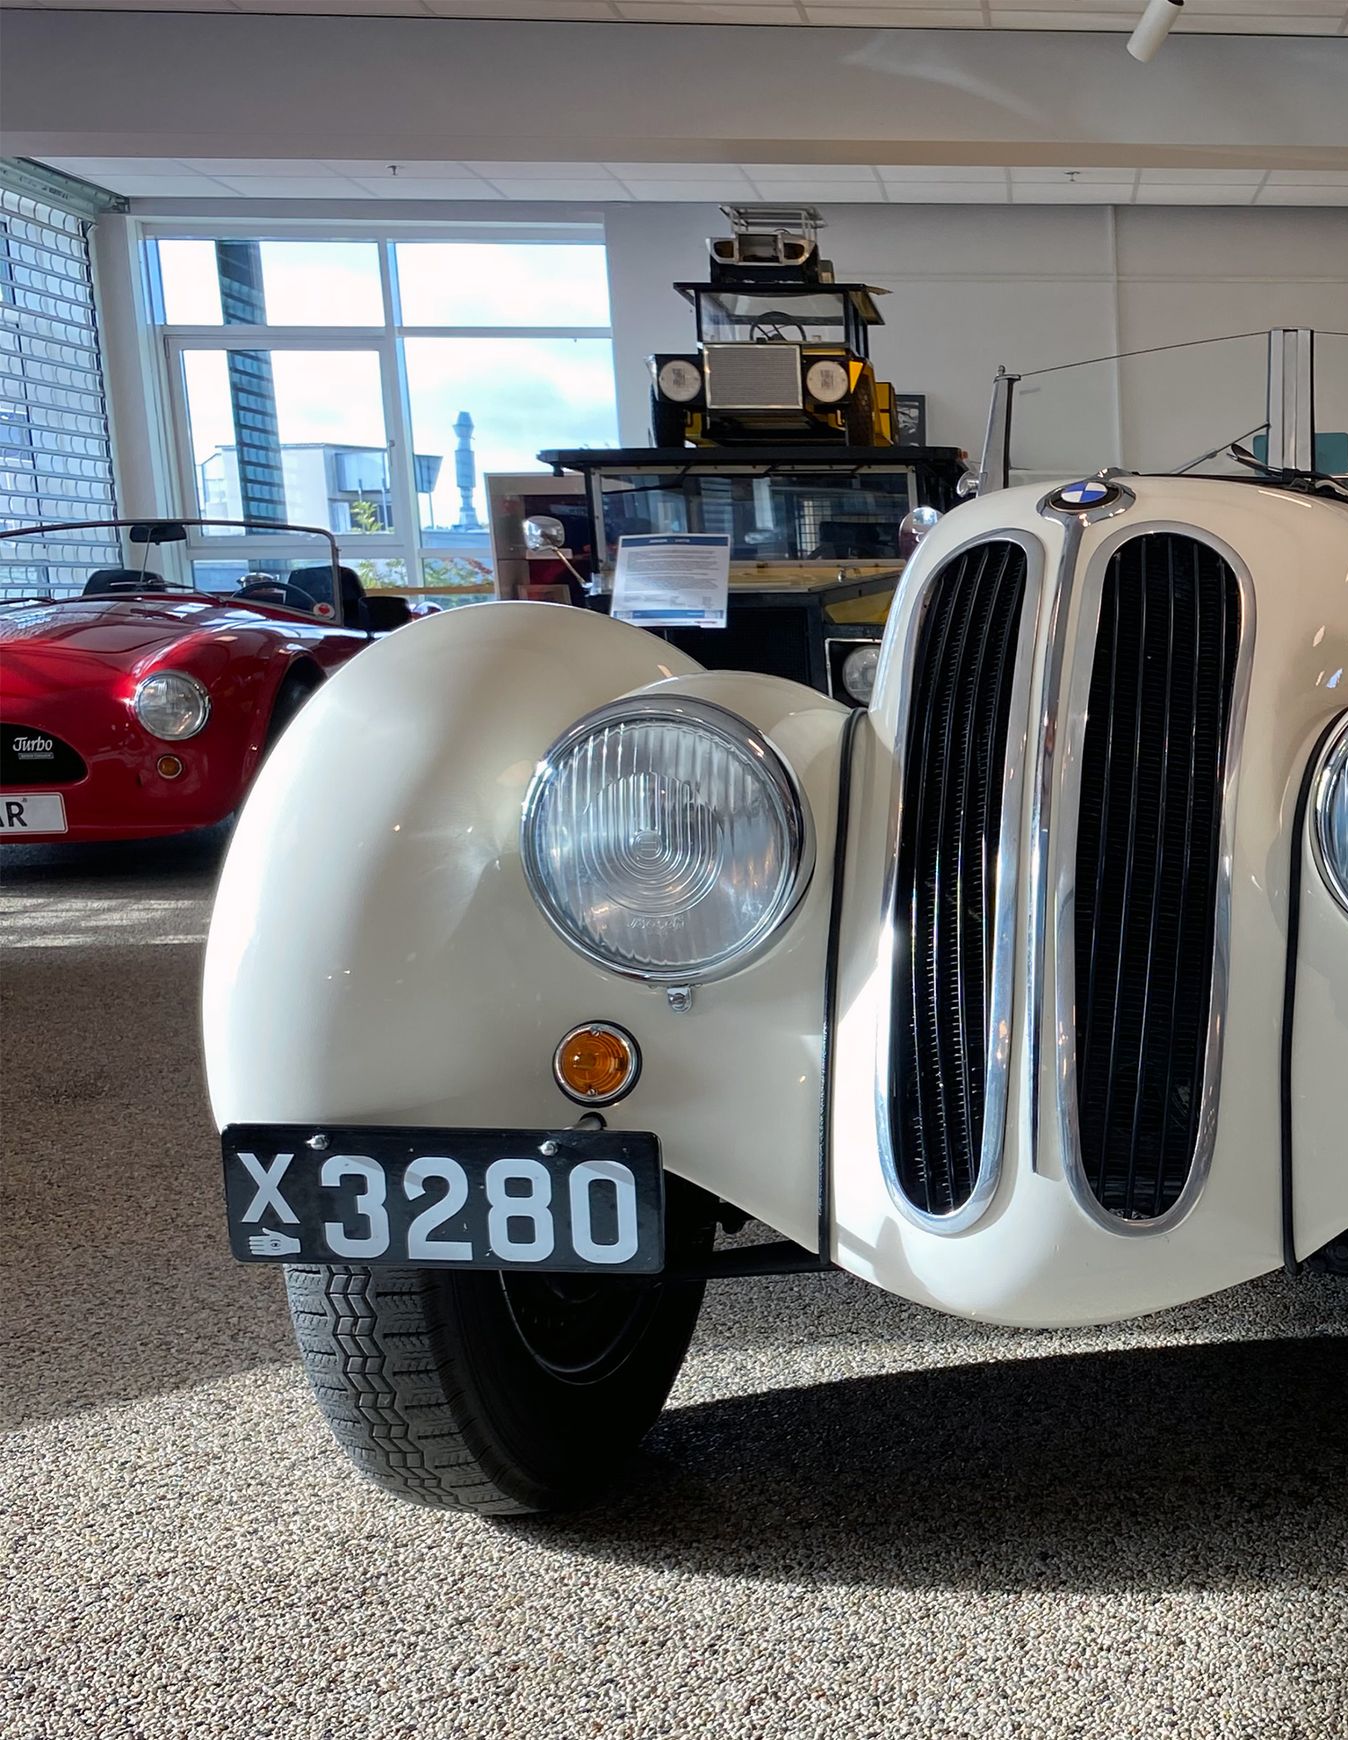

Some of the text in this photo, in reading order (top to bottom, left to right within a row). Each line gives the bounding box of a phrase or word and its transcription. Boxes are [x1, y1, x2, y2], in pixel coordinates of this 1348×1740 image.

[12, 736, 53, 751] Turbo
[0, 801, 28, 827] R
[237, 1153, 638, 1264] X 3280
